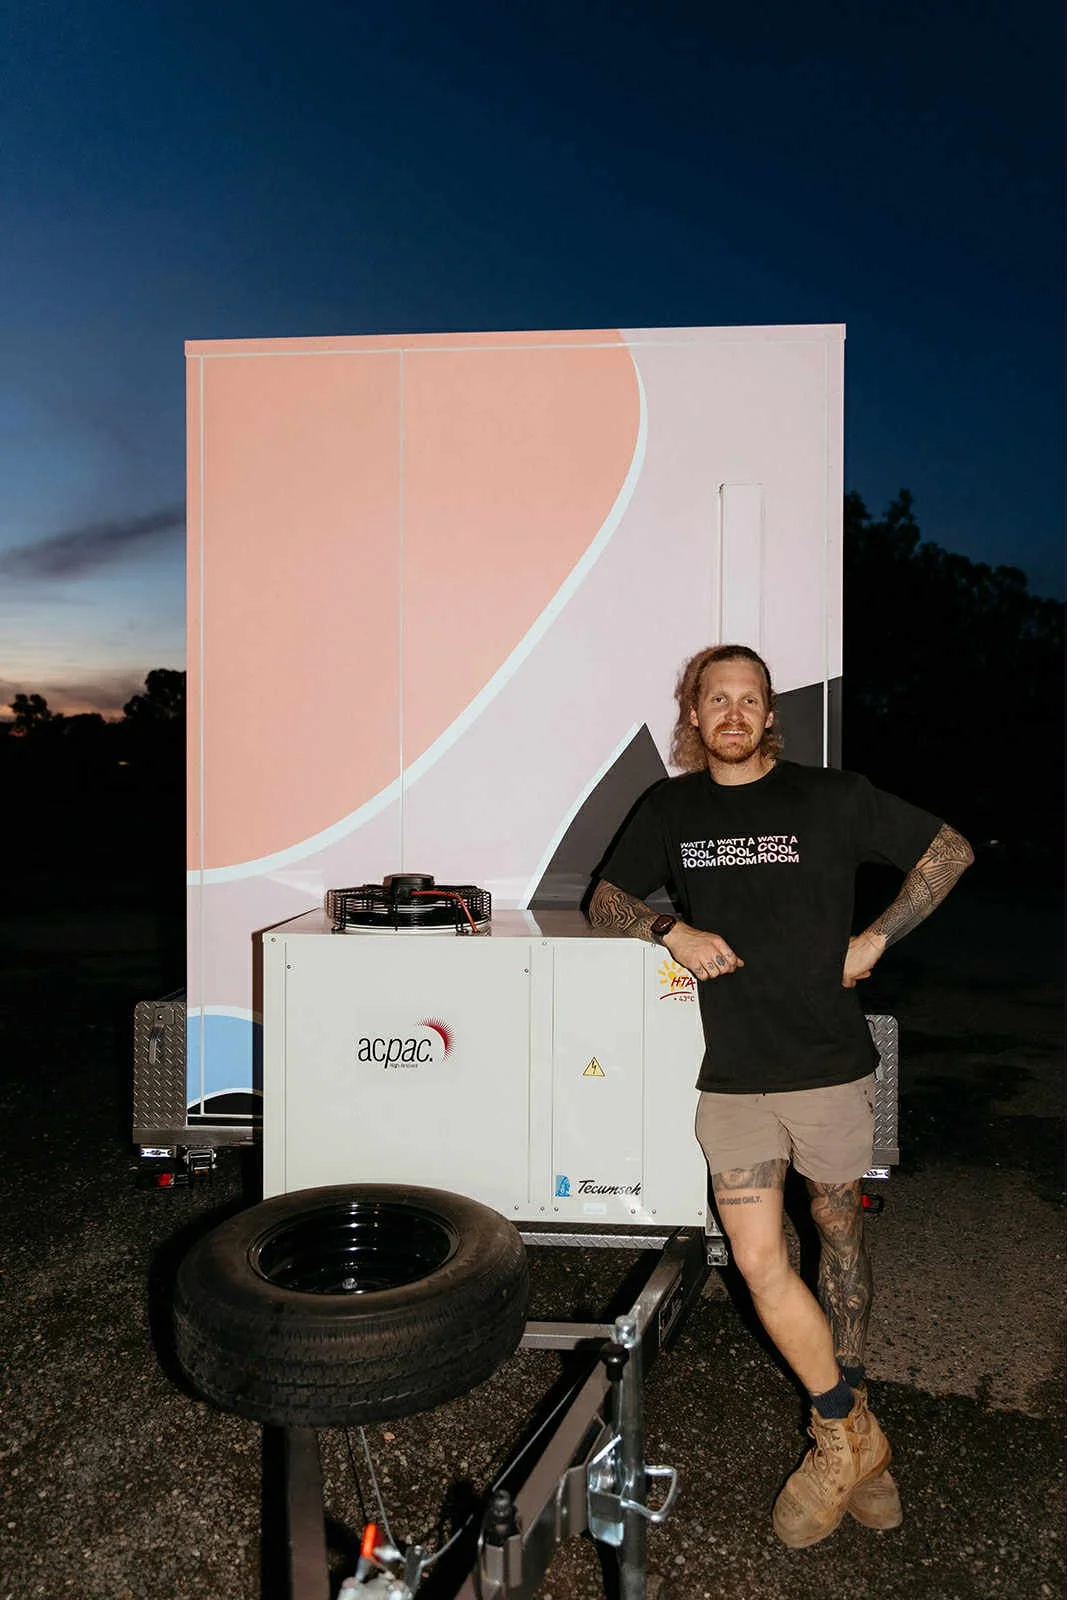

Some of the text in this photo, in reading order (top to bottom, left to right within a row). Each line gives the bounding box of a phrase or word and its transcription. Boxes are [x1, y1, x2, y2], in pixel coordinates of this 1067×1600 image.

[680, 835, 798, 849] WATT A WATT A WATT A
[680, 842, 797, 859] COOL COOL COOL
[717, 855, 757, 866] ROOM
[758, 852, 800, 863] ROOM
[671, 976, 696, 990] HTA
